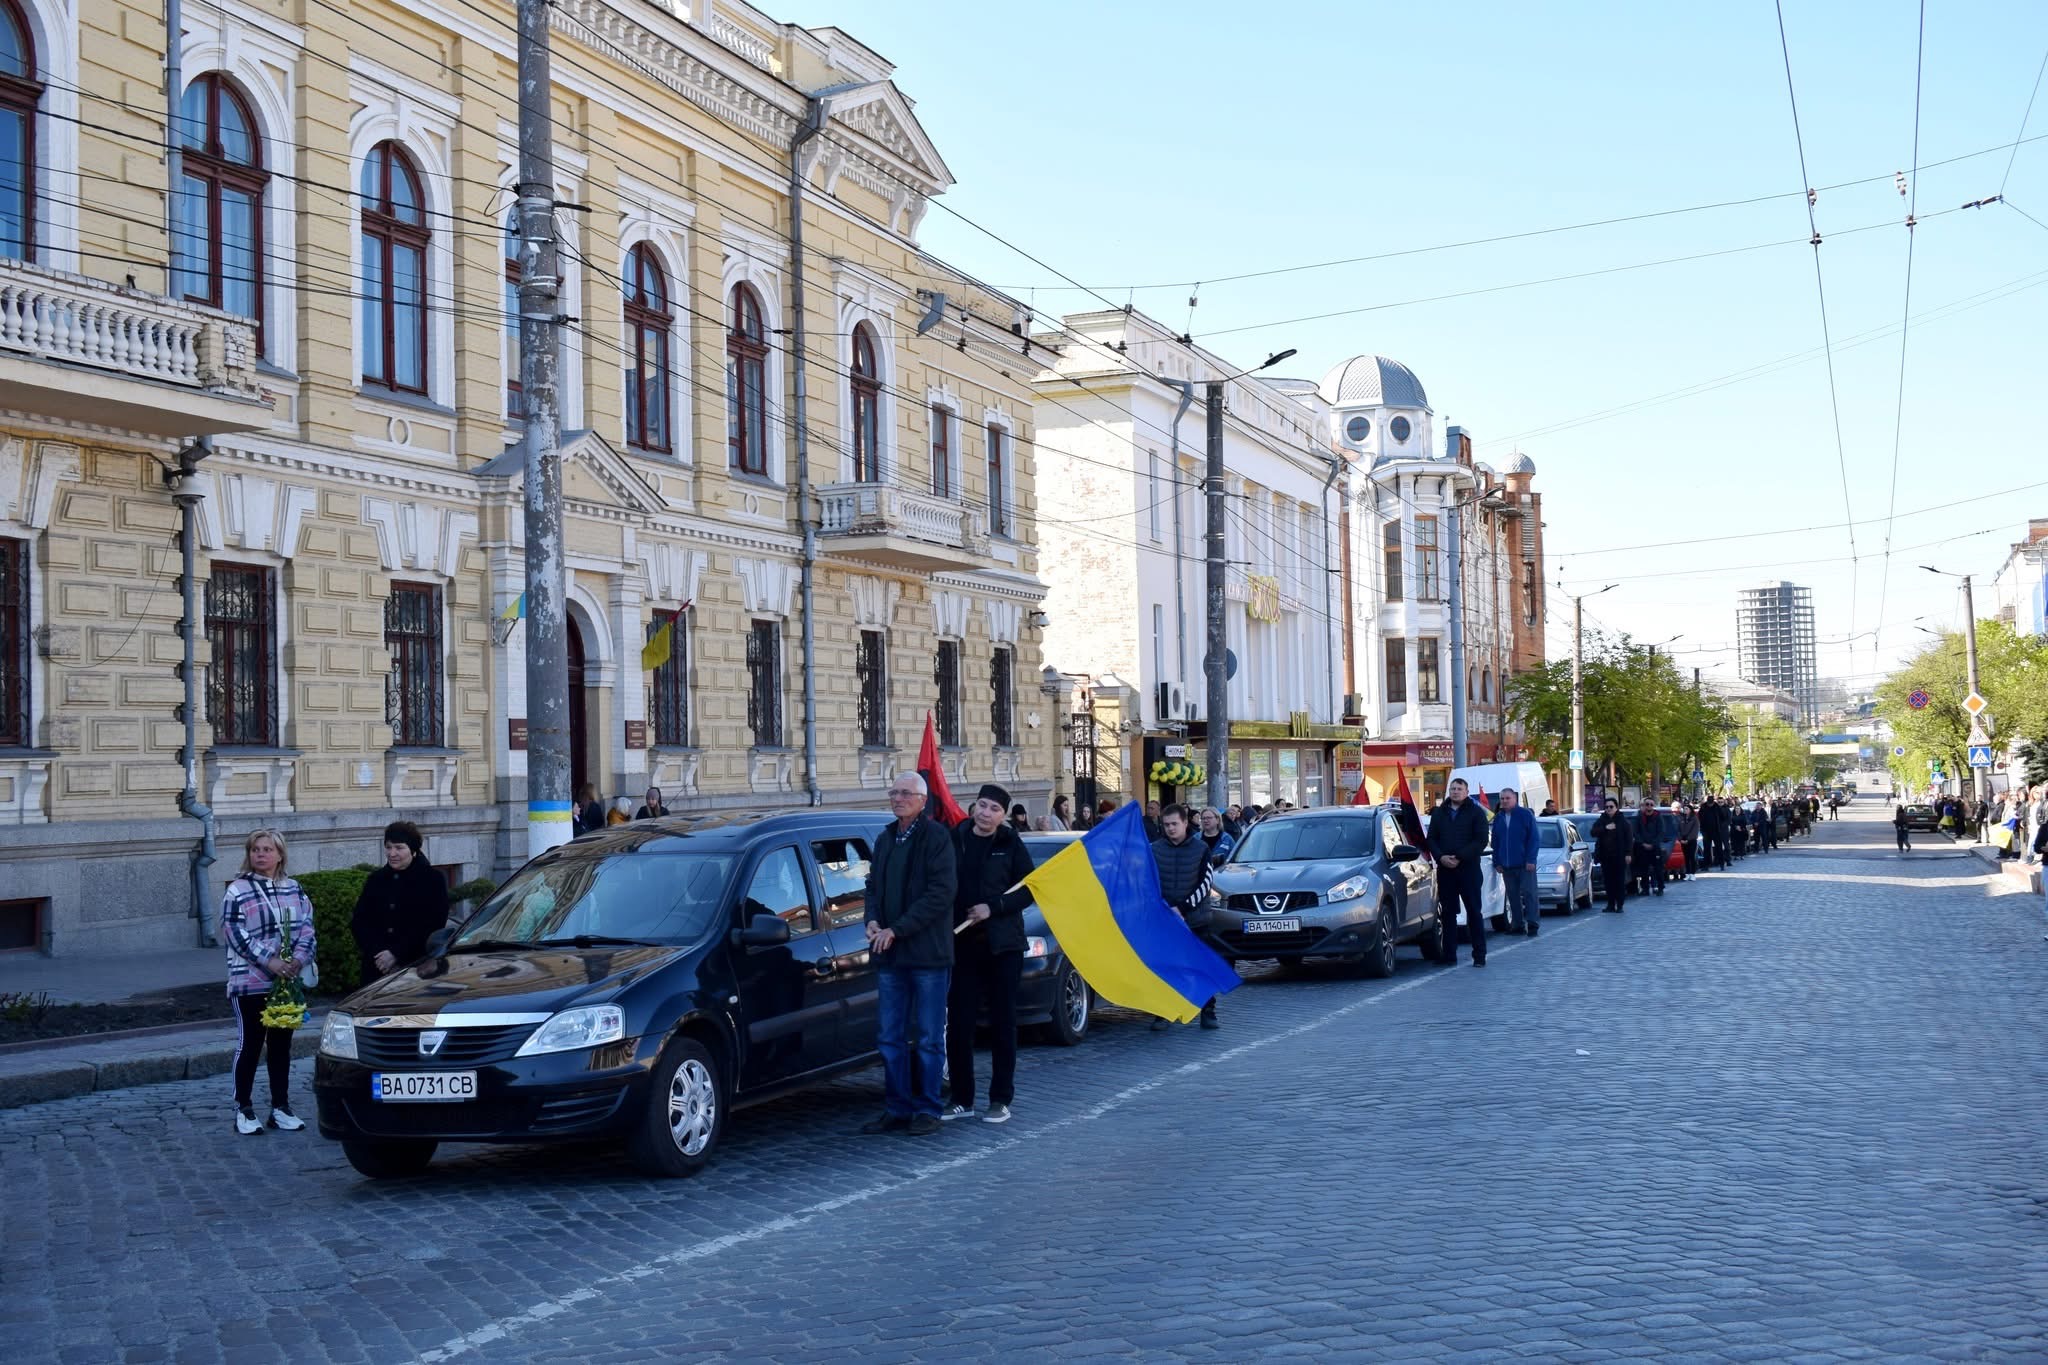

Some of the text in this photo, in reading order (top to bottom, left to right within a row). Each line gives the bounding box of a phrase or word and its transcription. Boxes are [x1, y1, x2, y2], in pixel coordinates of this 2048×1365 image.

[1420, 750, 1454, 758] ДЗЕРКАЛ
[1249, 922, 1262, 932] BA
[1263, 921, 1282, 931] 1140
[381, 1076, 473, 1095] BA 0731 CB
